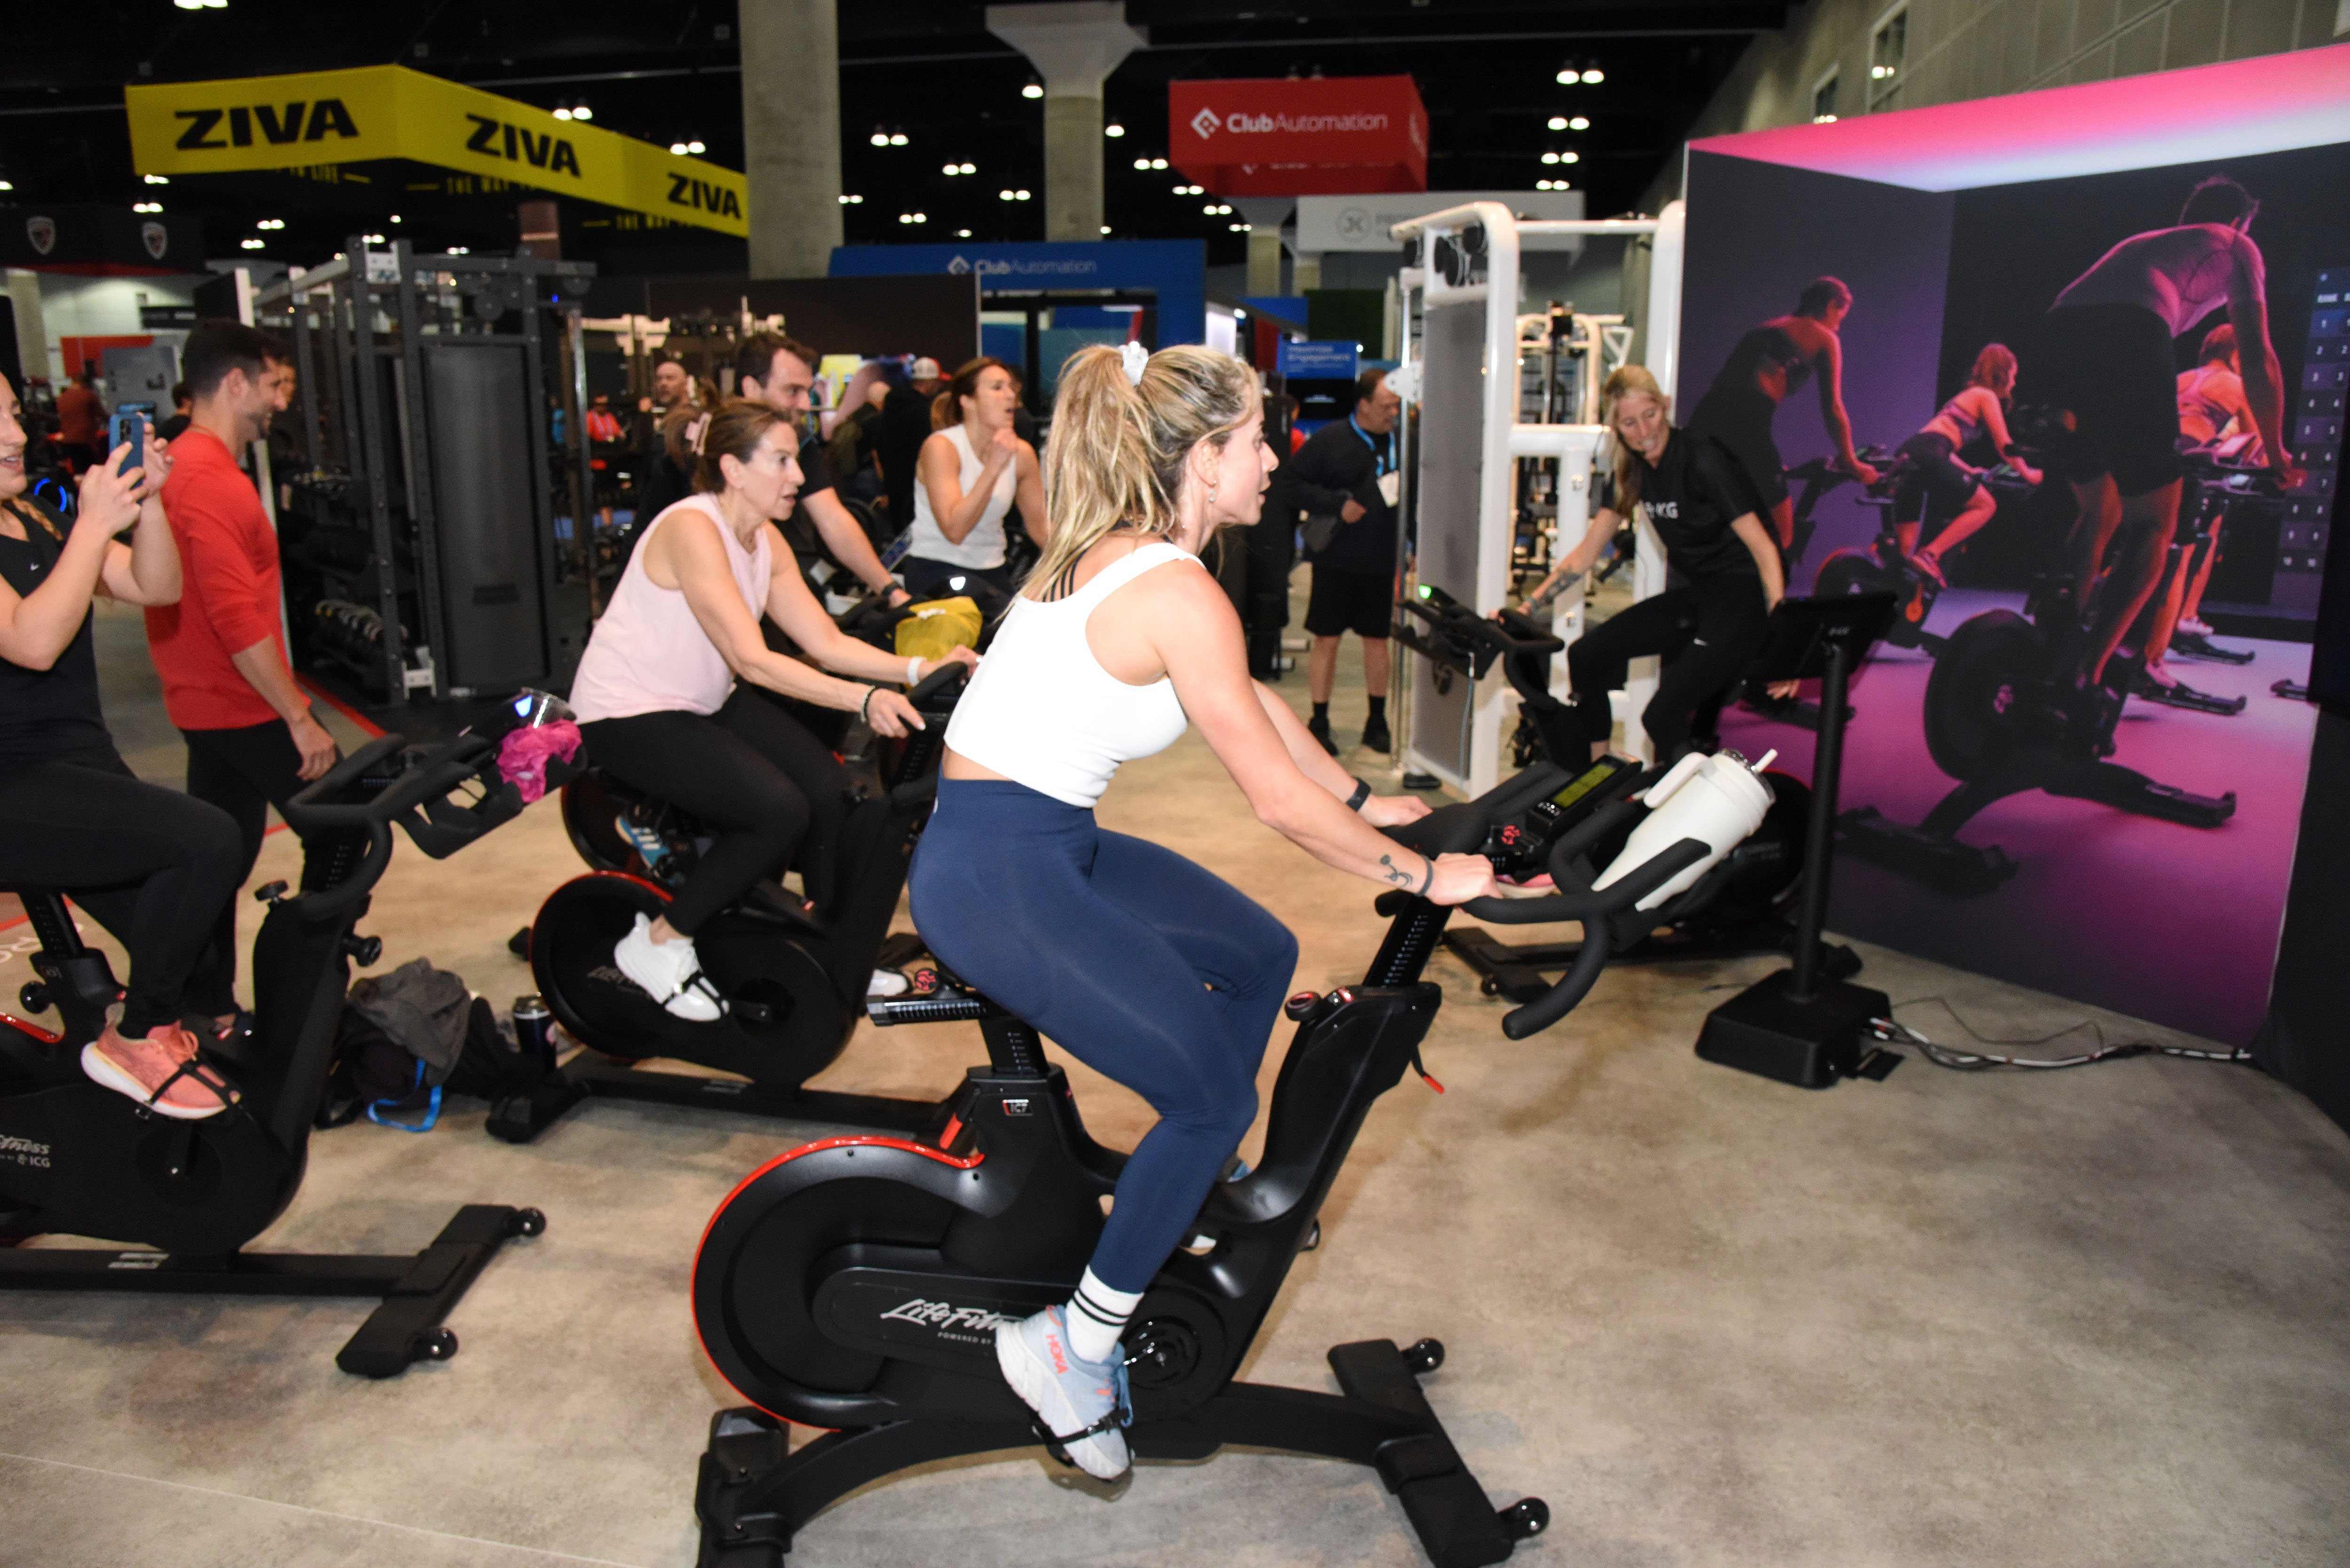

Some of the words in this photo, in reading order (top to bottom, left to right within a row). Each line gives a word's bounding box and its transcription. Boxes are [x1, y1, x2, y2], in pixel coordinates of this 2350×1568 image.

[173, 98, 360, 150] ZIVA
[1226, 110, 1388, 133] ClubAutomation
[465, 113, 582, 178] ZIVA
[667, 172, 742, 220] ZIVA
[974, 258, 1097, 275] ClubAutomation
[1045, 1334, 1069, 1374] HOKA
